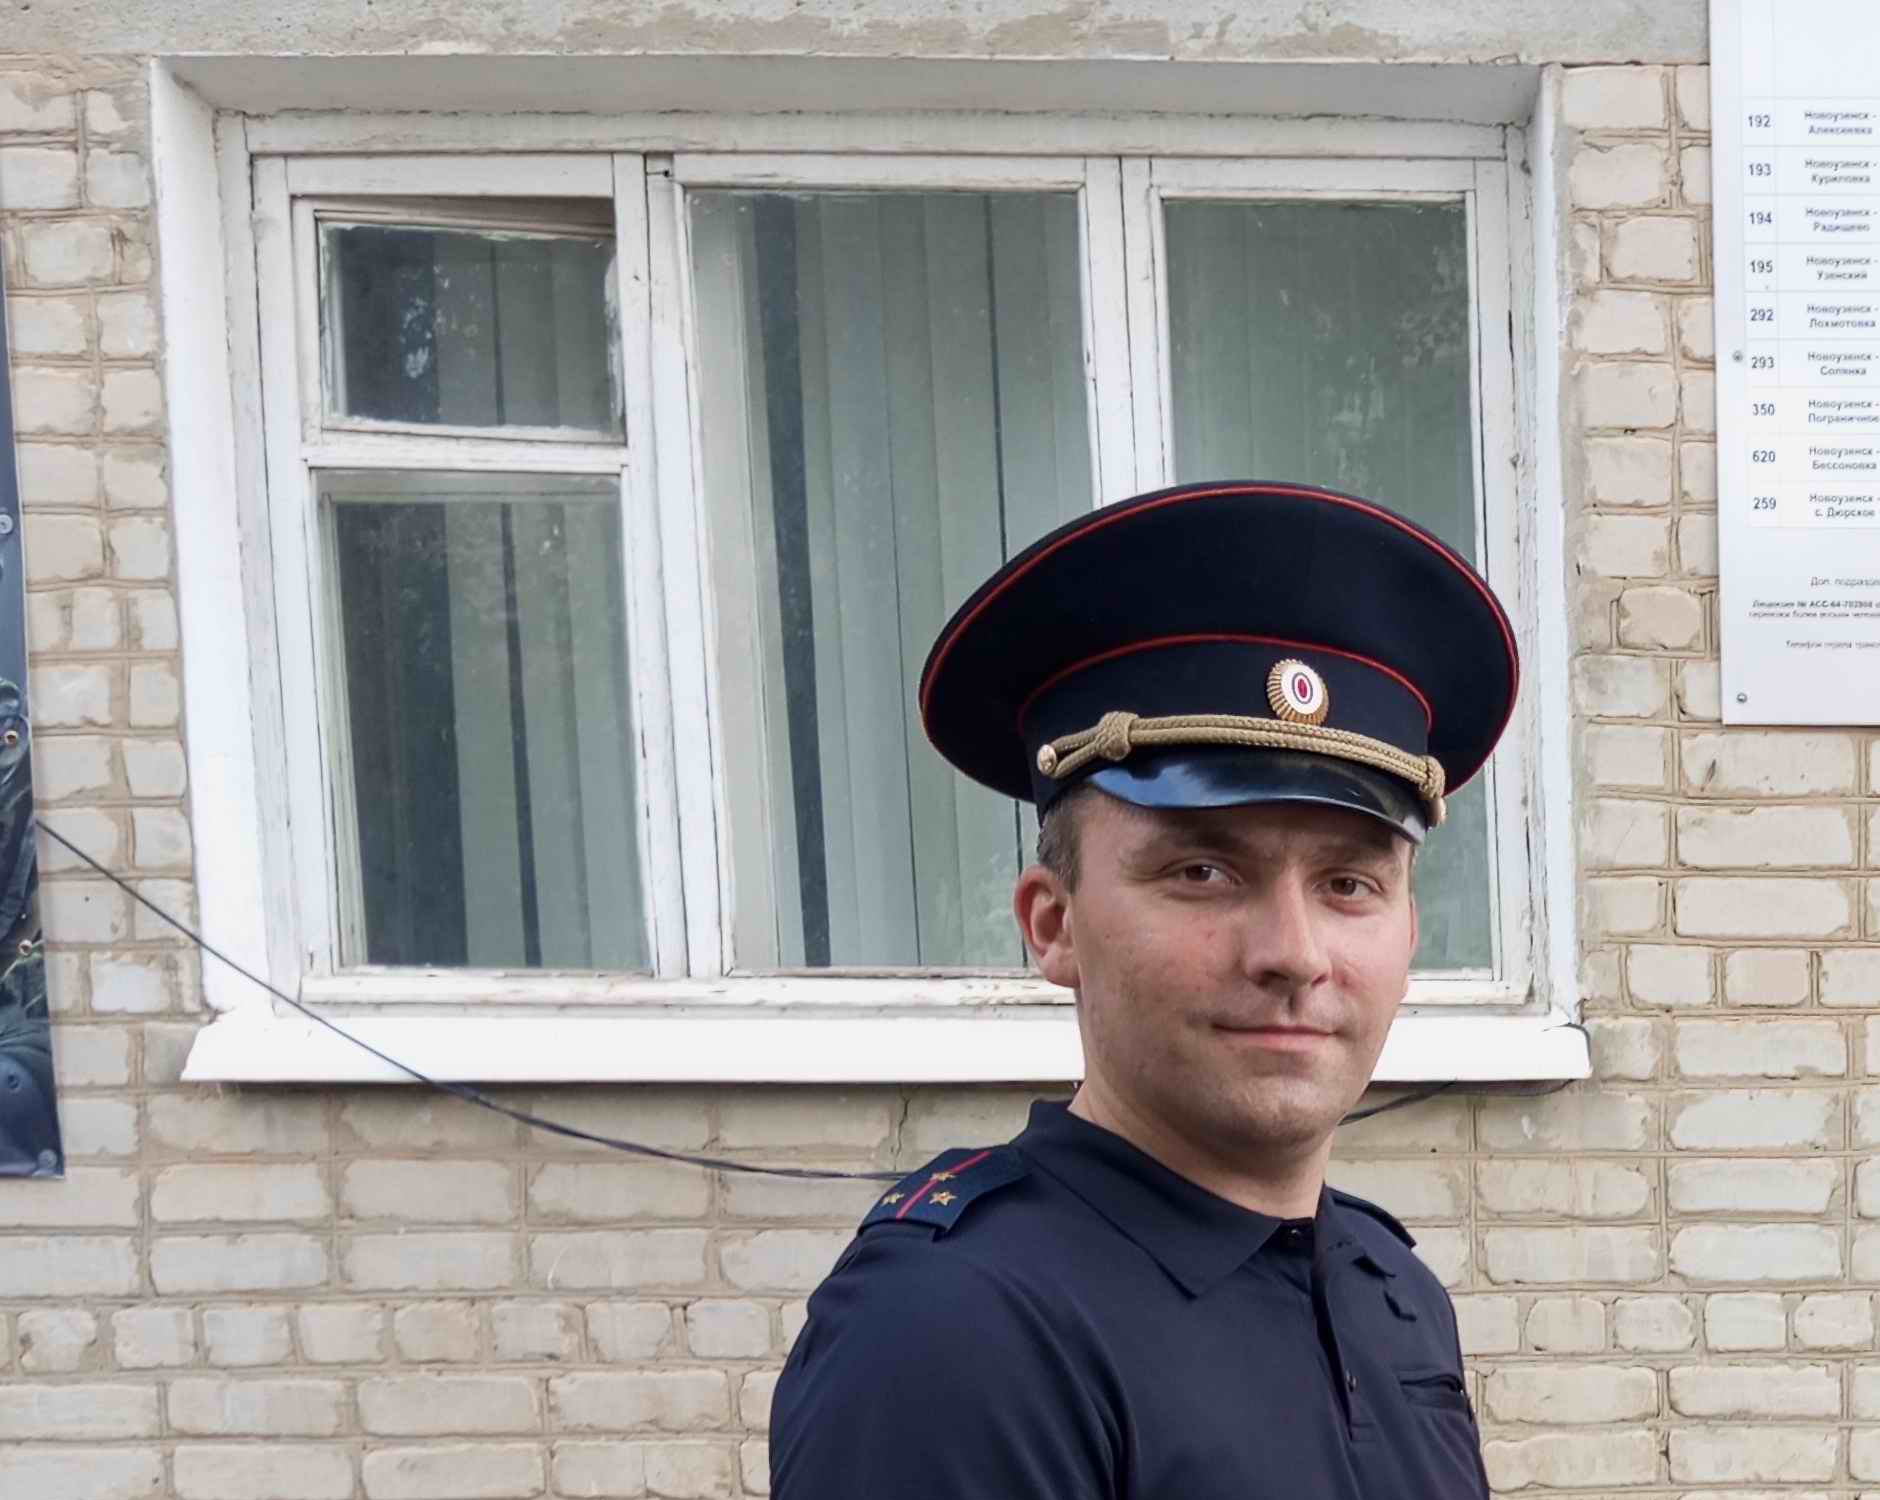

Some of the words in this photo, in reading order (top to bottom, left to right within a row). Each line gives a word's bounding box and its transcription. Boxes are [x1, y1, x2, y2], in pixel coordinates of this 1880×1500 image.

[1748, 115, 1770, 127] 192
[1749, 163, 1771, 176] 193
[1750, 212, 1772, 224] 194
[1750, 260, 1773, 273] 195
[1751, 309, 1773, 321] 292
[1752, 356, 1774, 368] 293
[1753, 403, 1775, 416] 350
[1753, 450, 1775, 463] 620
[1754, 497, 1776, 509] 259
